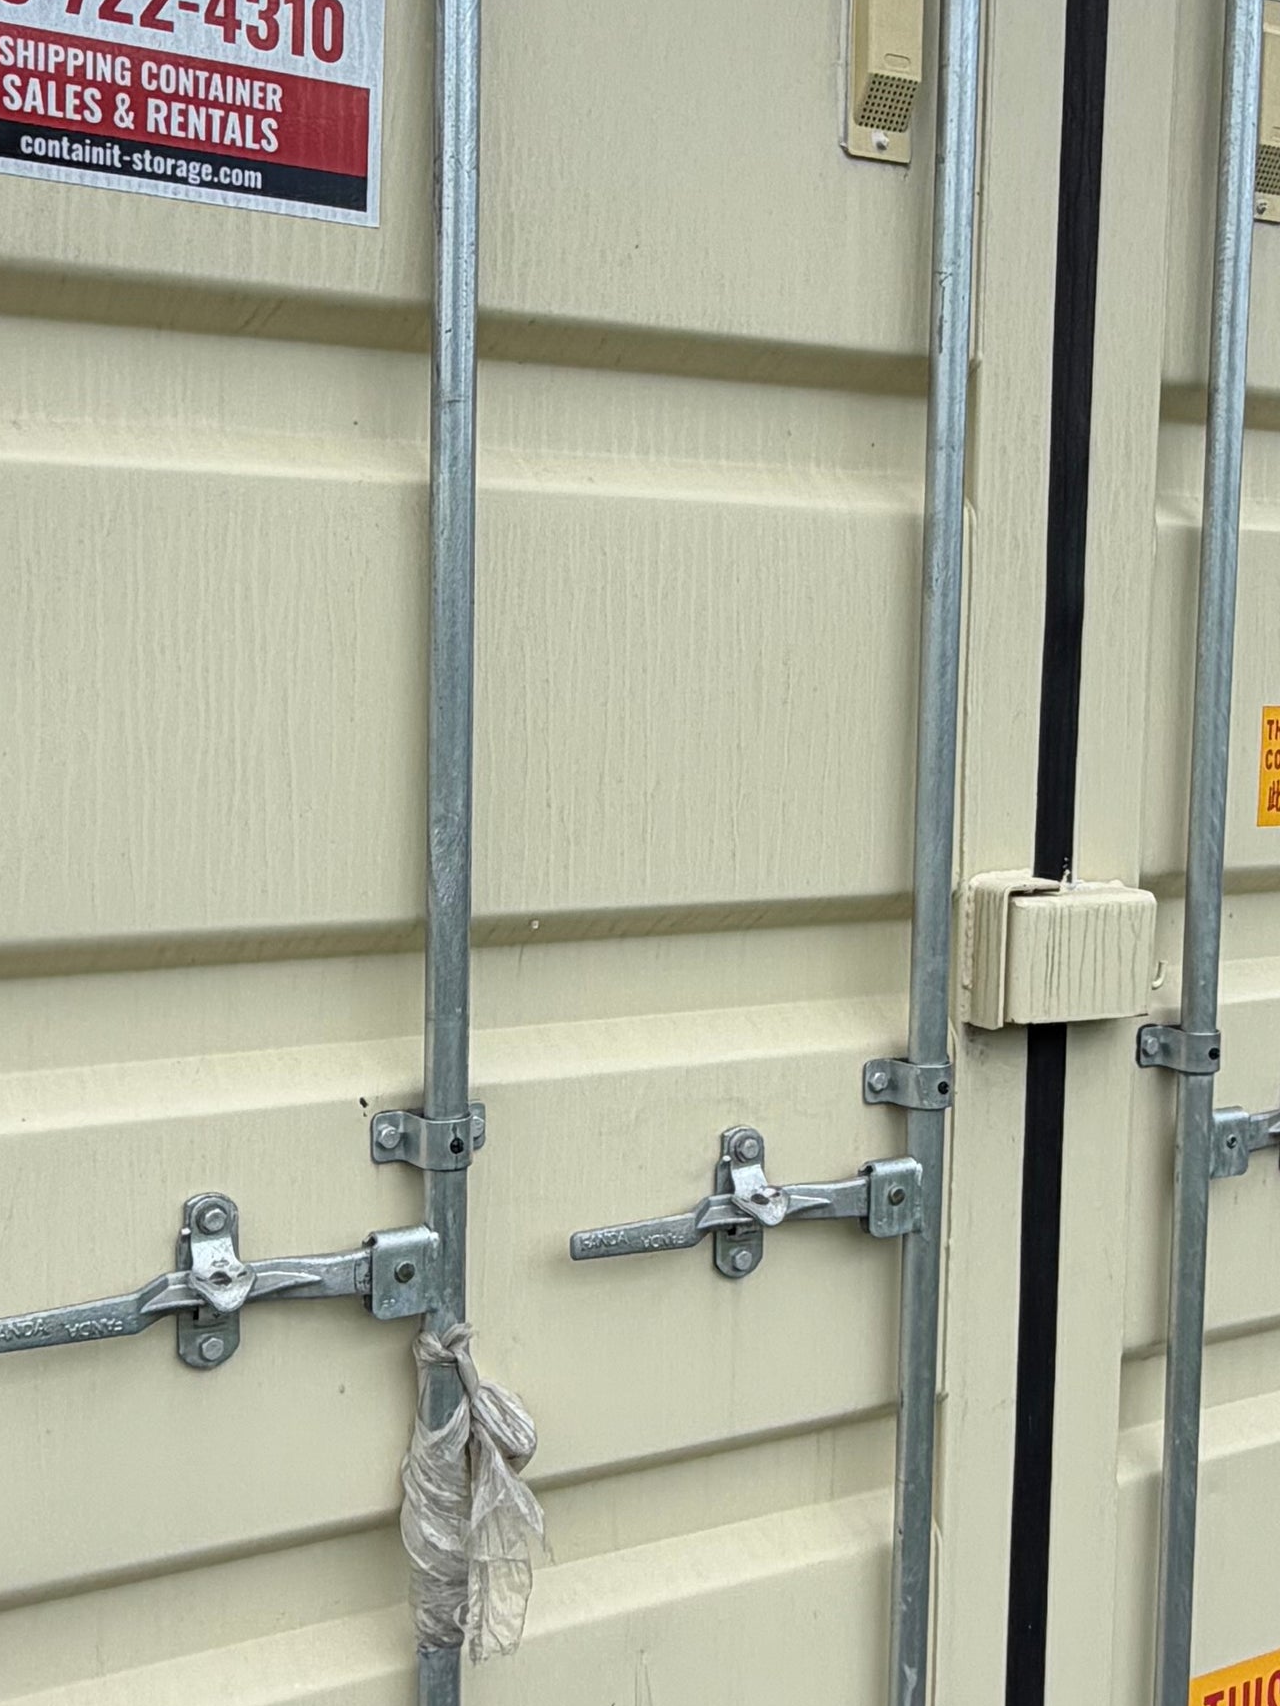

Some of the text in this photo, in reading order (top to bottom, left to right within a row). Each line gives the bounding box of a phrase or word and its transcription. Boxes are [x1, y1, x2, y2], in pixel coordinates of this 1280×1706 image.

[2, 74, 279, 152] SALES & RENTALS
[141, 61, 282, 112] CONTAINER
[20, 135, 262, 189] containit-storage.com
